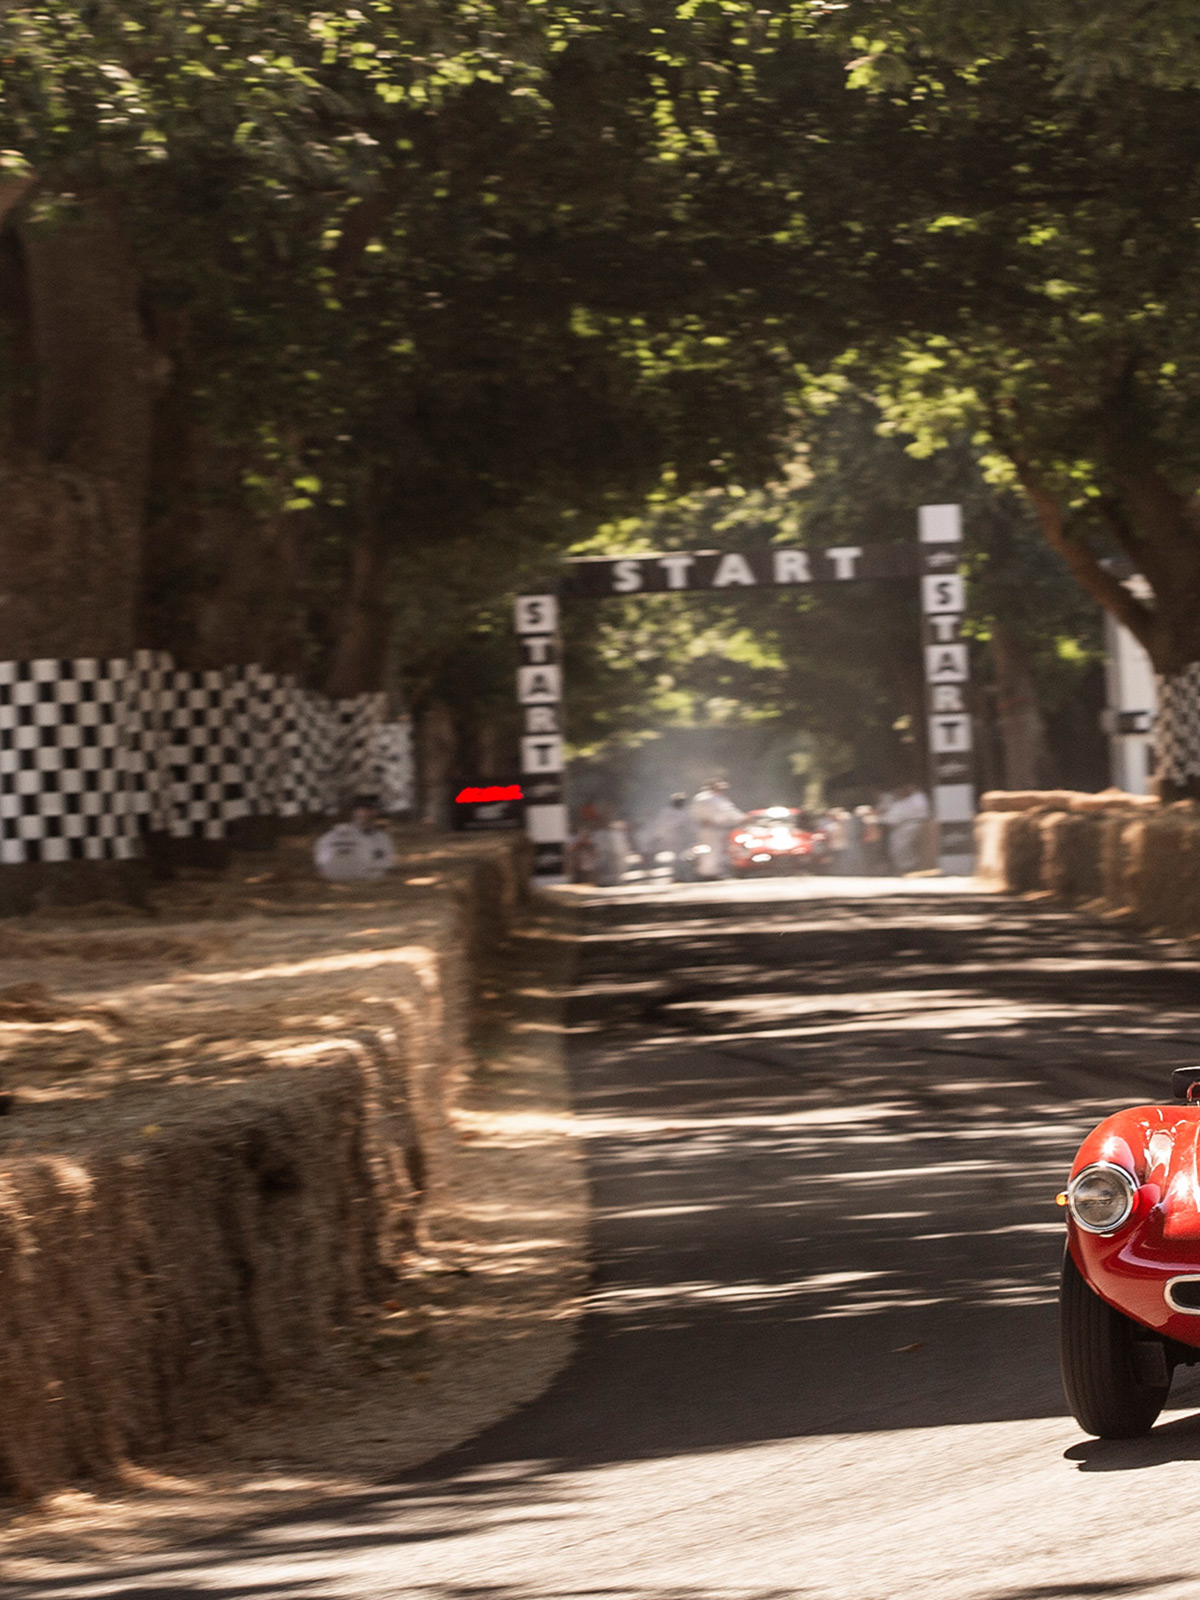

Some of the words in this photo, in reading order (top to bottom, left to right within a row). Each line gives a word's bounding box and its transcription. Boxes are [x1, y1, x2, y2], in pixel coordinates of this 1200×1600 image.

[611, 546, 863, 592] START
[521, 601, 556, 767] START
[928, 581, 963, 746] START
